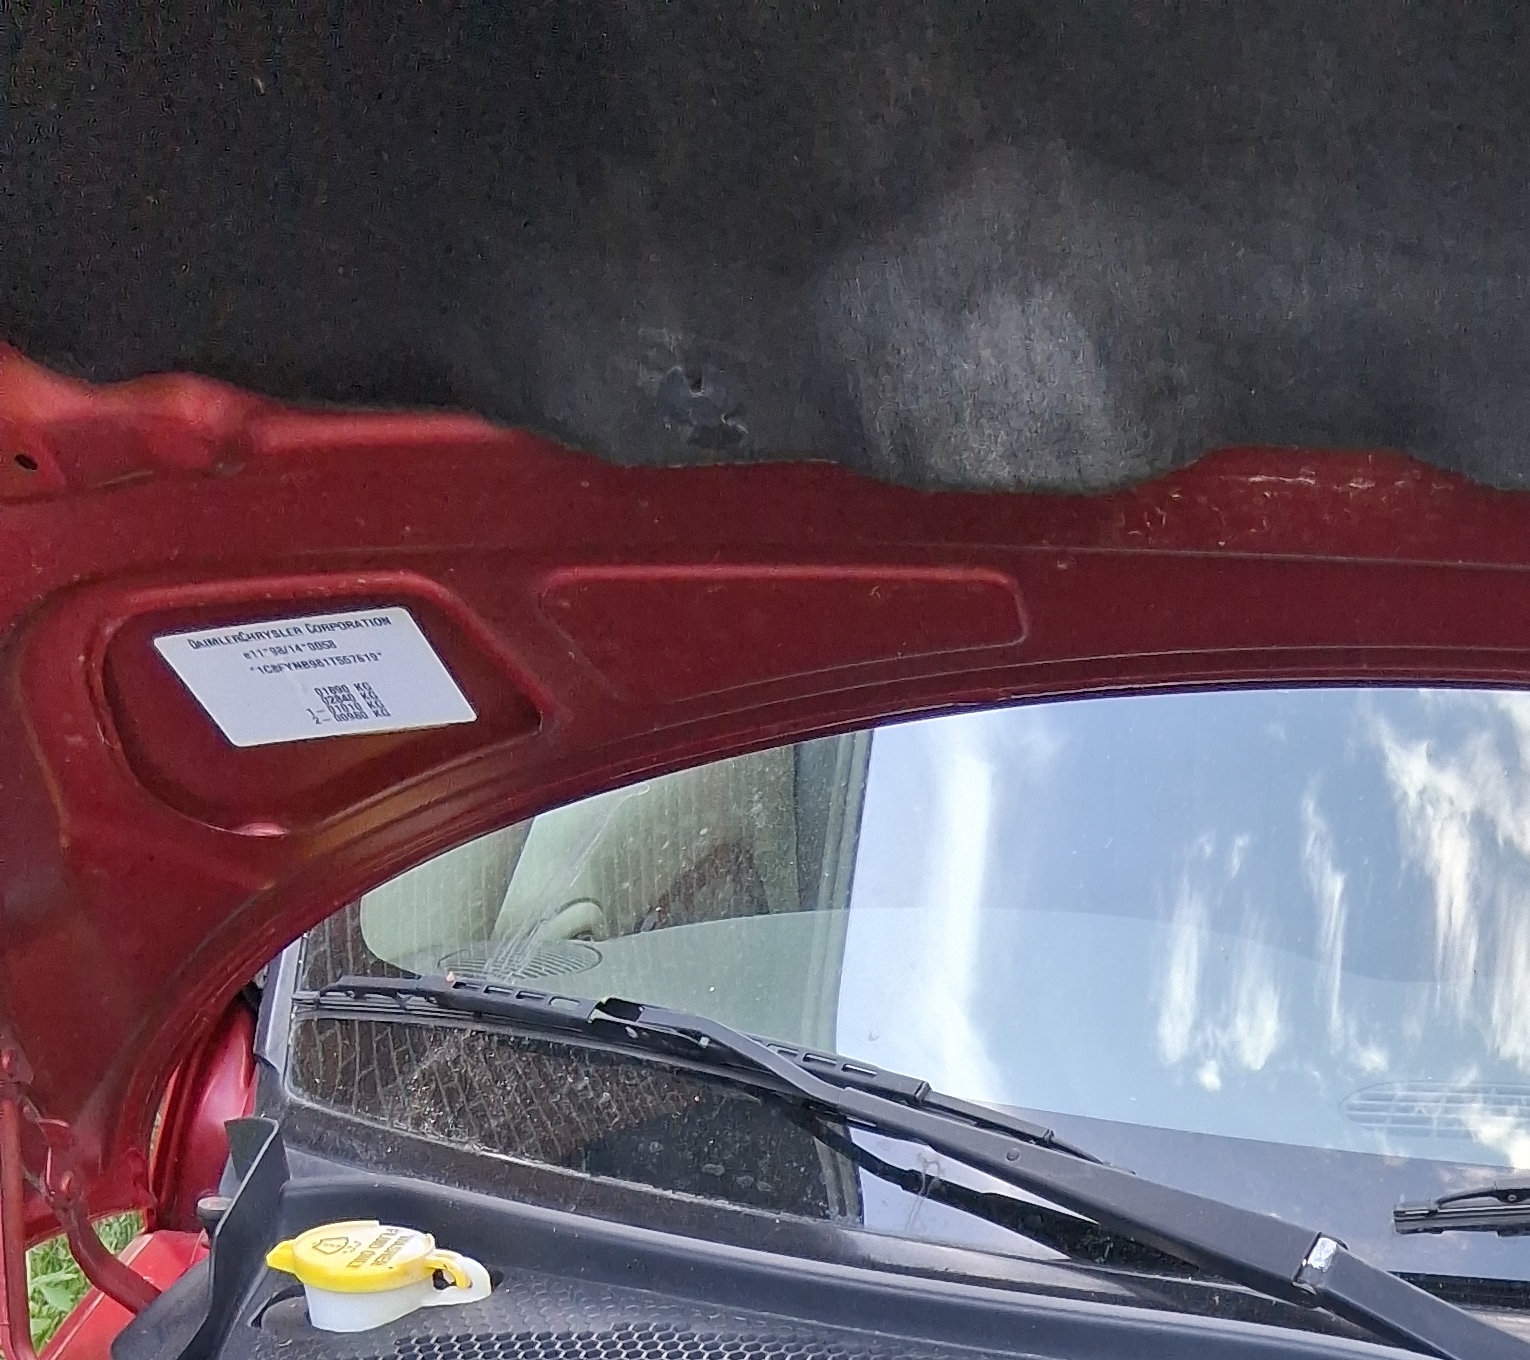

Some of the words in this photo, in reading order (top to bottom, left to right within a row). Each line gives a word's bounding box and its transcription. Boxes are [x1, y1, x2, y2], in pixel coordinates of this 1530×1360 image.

[305, 616, 392, 635] CORPORATION
[353, 681, 371, 692] KG
[360, 689, 378, 700] KG
[366, 699, 385, 710] KG
